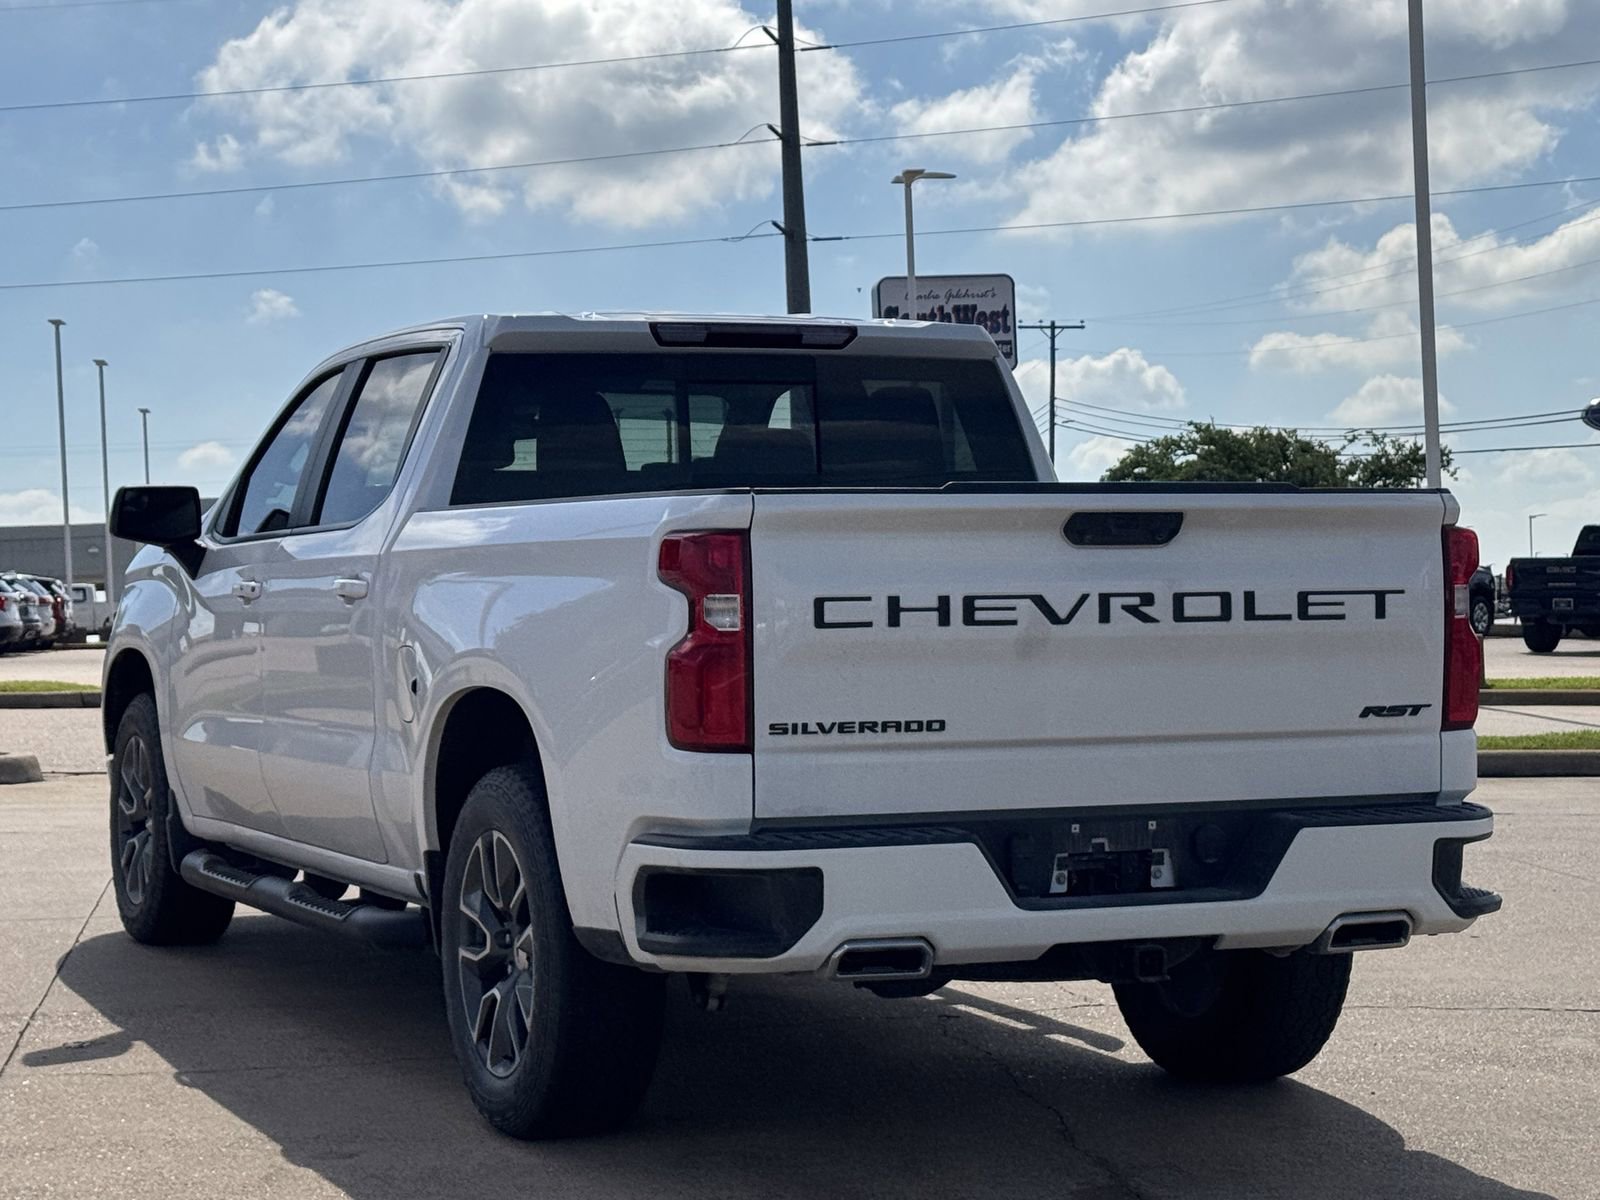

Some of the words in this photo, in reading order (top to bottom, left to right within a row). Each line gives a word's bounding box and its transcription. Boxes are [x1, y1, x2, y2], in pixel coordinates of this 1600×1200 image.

[904, 289, 941, 301] arlie
[813, 589, 1405, 629] CHEVROLET
[1358, 703, 1433, 718] RST
[768, 719, 946, 736] SILVERADO
